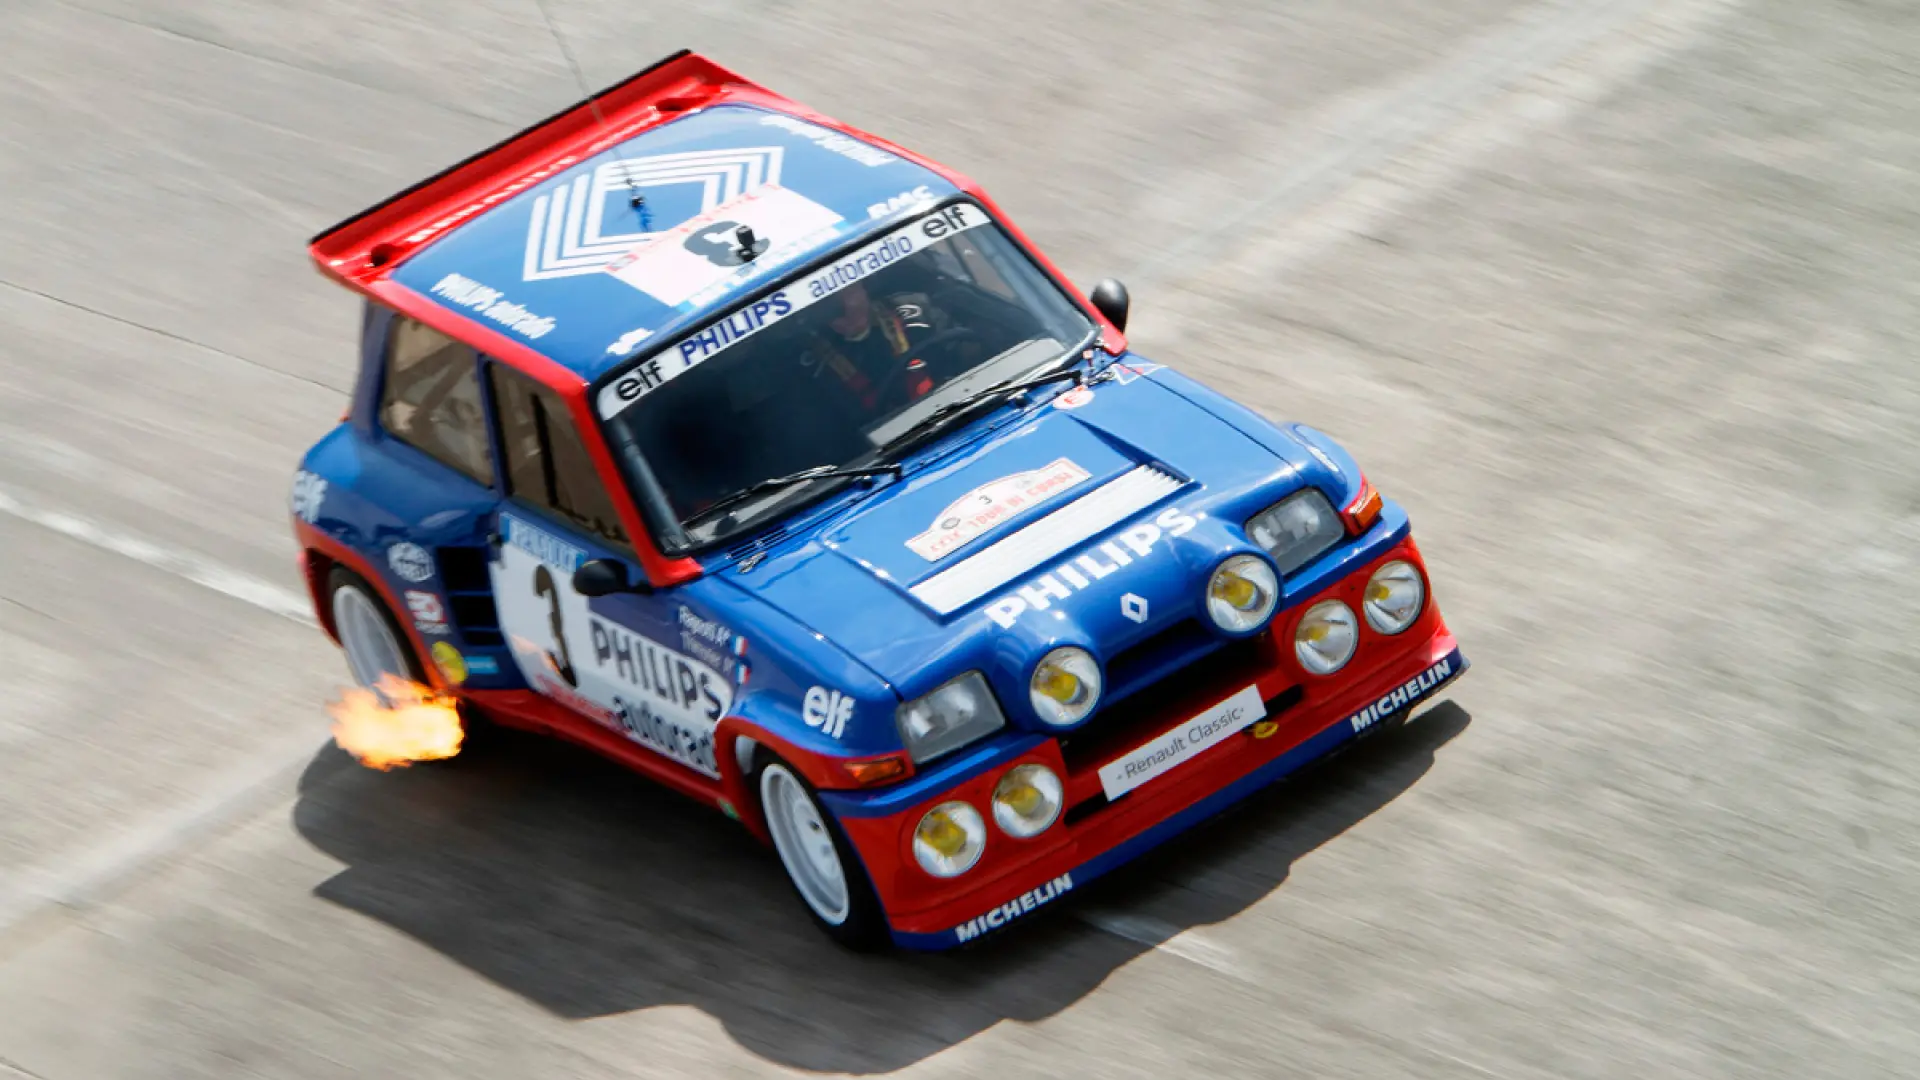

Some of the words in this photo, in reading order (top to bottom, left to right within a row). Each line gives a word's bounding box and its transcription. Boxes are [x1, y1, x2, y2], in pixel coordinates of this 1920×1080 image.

[922, 206, 968, 239] elf
[680, 291, 793, 366] PHILIPS
[809, 235, 913, 298] autoradio
[615, 360, 665, 401] elf
[978, 495, 993, 505] 3
[984, 508, 1196, 629] PHILIPS
[533, 564, 576, 688] 3
[590, 619, 722, 722] PHILIPS
[1351, 660, 1451, 732] MICHELIN
[803, 685, 855, 739] elf
[955, 873, 1072, 942] MICHELIN
